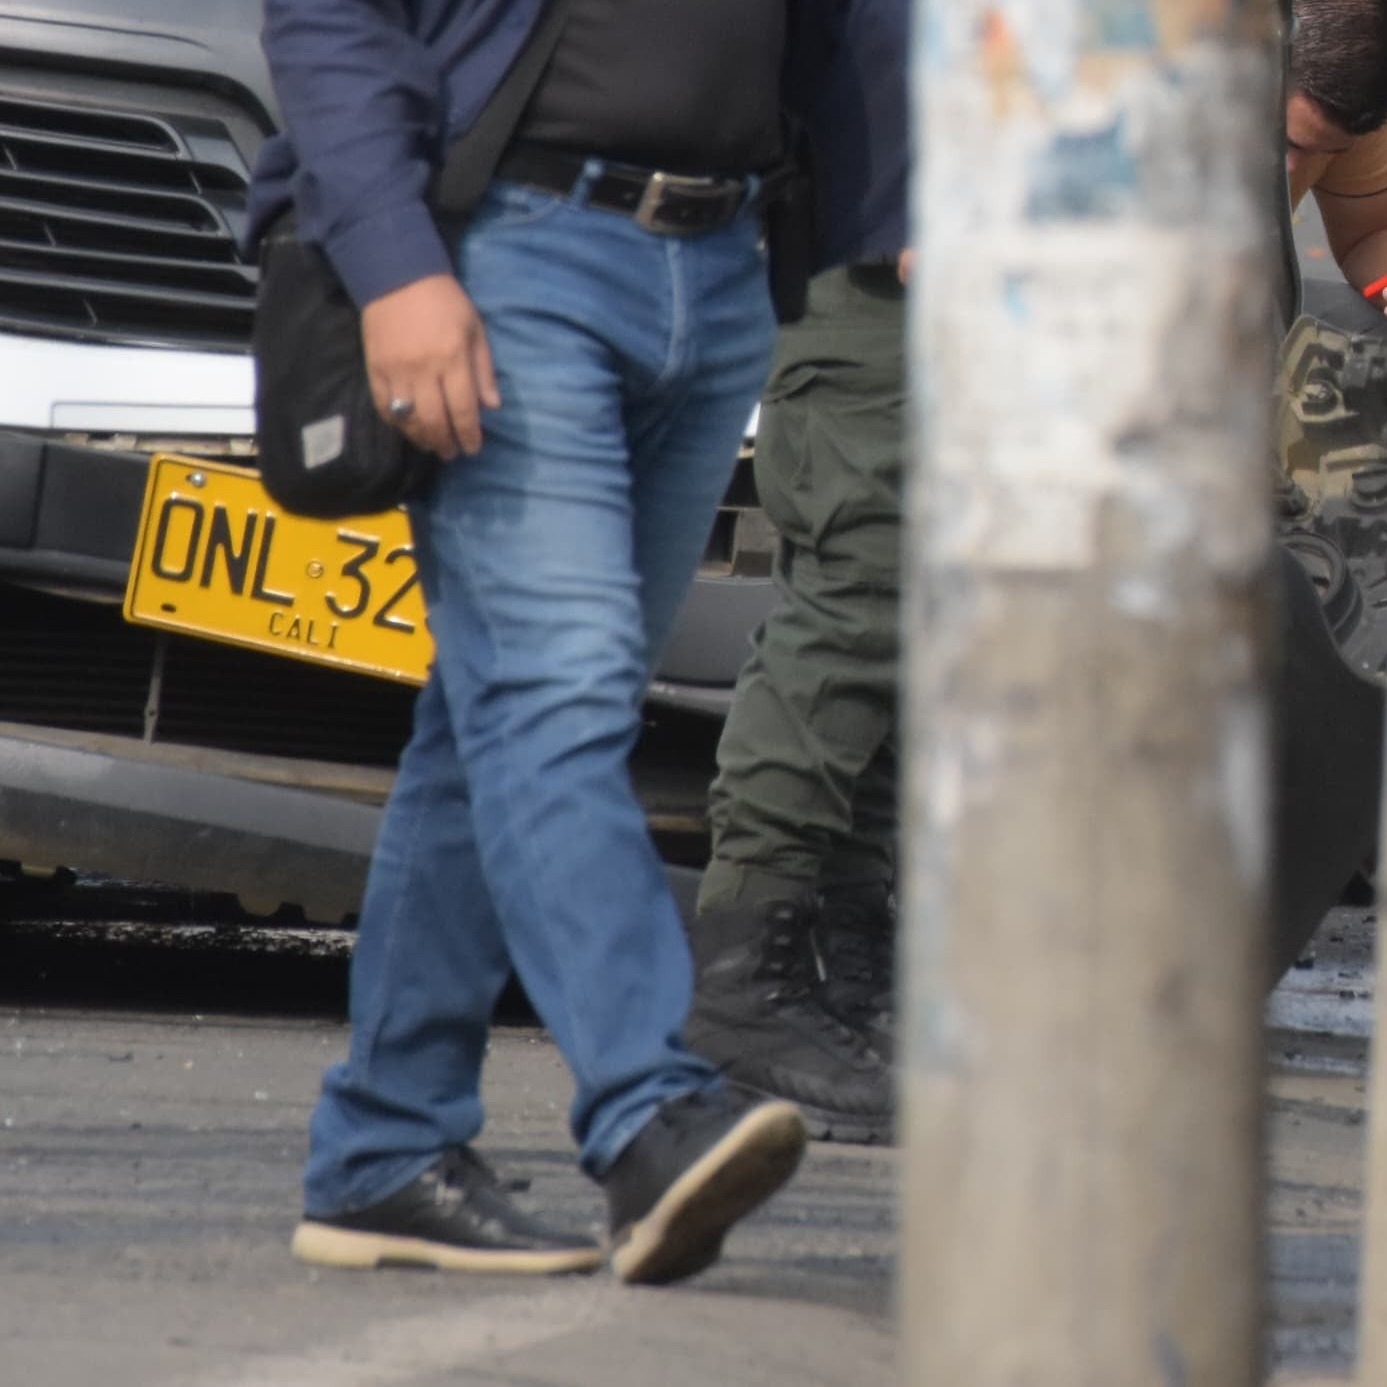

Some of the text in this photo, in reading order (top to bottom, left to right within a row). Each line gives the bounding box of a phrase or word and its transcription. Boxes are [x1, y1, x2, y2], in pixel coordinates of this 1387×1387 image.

[151, 491, 425, 636] ONL 32
[267, 611, 340, 650] CALI
